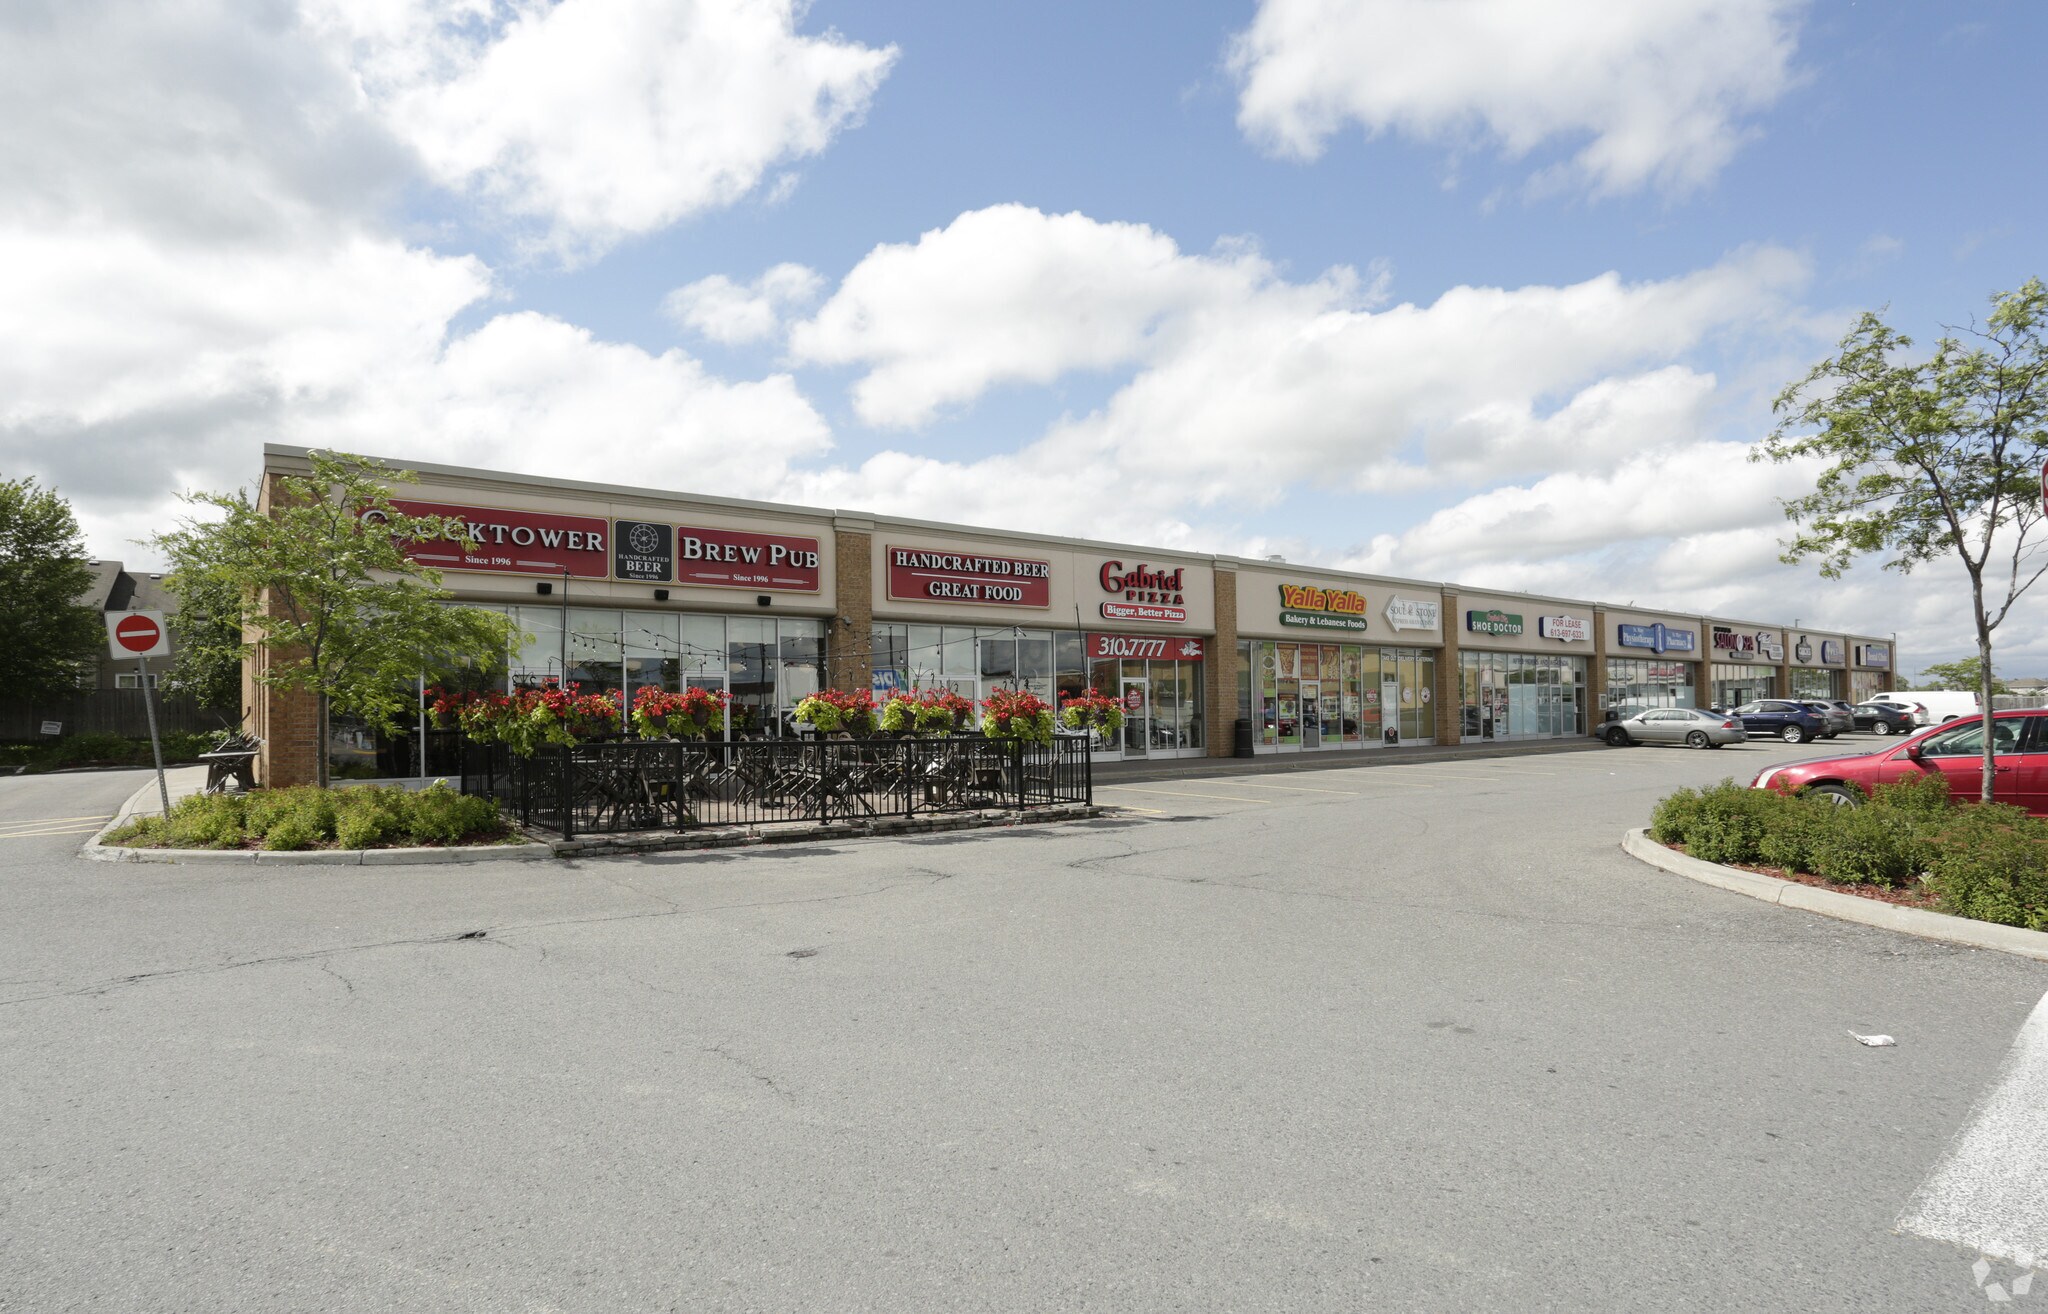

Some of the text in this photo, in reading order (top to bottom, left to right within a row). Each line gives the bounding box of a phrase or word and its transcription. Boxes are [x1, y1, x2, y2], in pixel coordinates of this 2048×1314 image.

[361, 509, 604, 551] COCKTOWER
[618, 554, 670, 562] HANDCRAFTED
[683, 537, 818, 568] BREW PUB
[465, 555, 511, 566] Since 1996
[626, 561, 661, 572] BEER
[896, 552, 1049, 577] HANDCRAFTED BEER
[733, 574, 769, 583] Since 1996
[1100, 561, 1184, 592] Gabriel
[929, 581, 1022, 600] GREAT FOOD
[1127, 590, 1184, 604] PIZZA
[1283, 585, 1366, 613] Yalla Yalla
[1107, 605, 1184, 618] Bigger, Better Pizza
[1285, 615, 1309, 625] Bakery
[1316, 617, 1346, 627] Lebanese
[1347, 620, 1366, 628] Foods
[1472, 621, 1522, 633] SHOE DOCTOR
[1552, 618, 1581, 628] FOR LEASE
[1098, 637, 1166, 657] 310.7777
